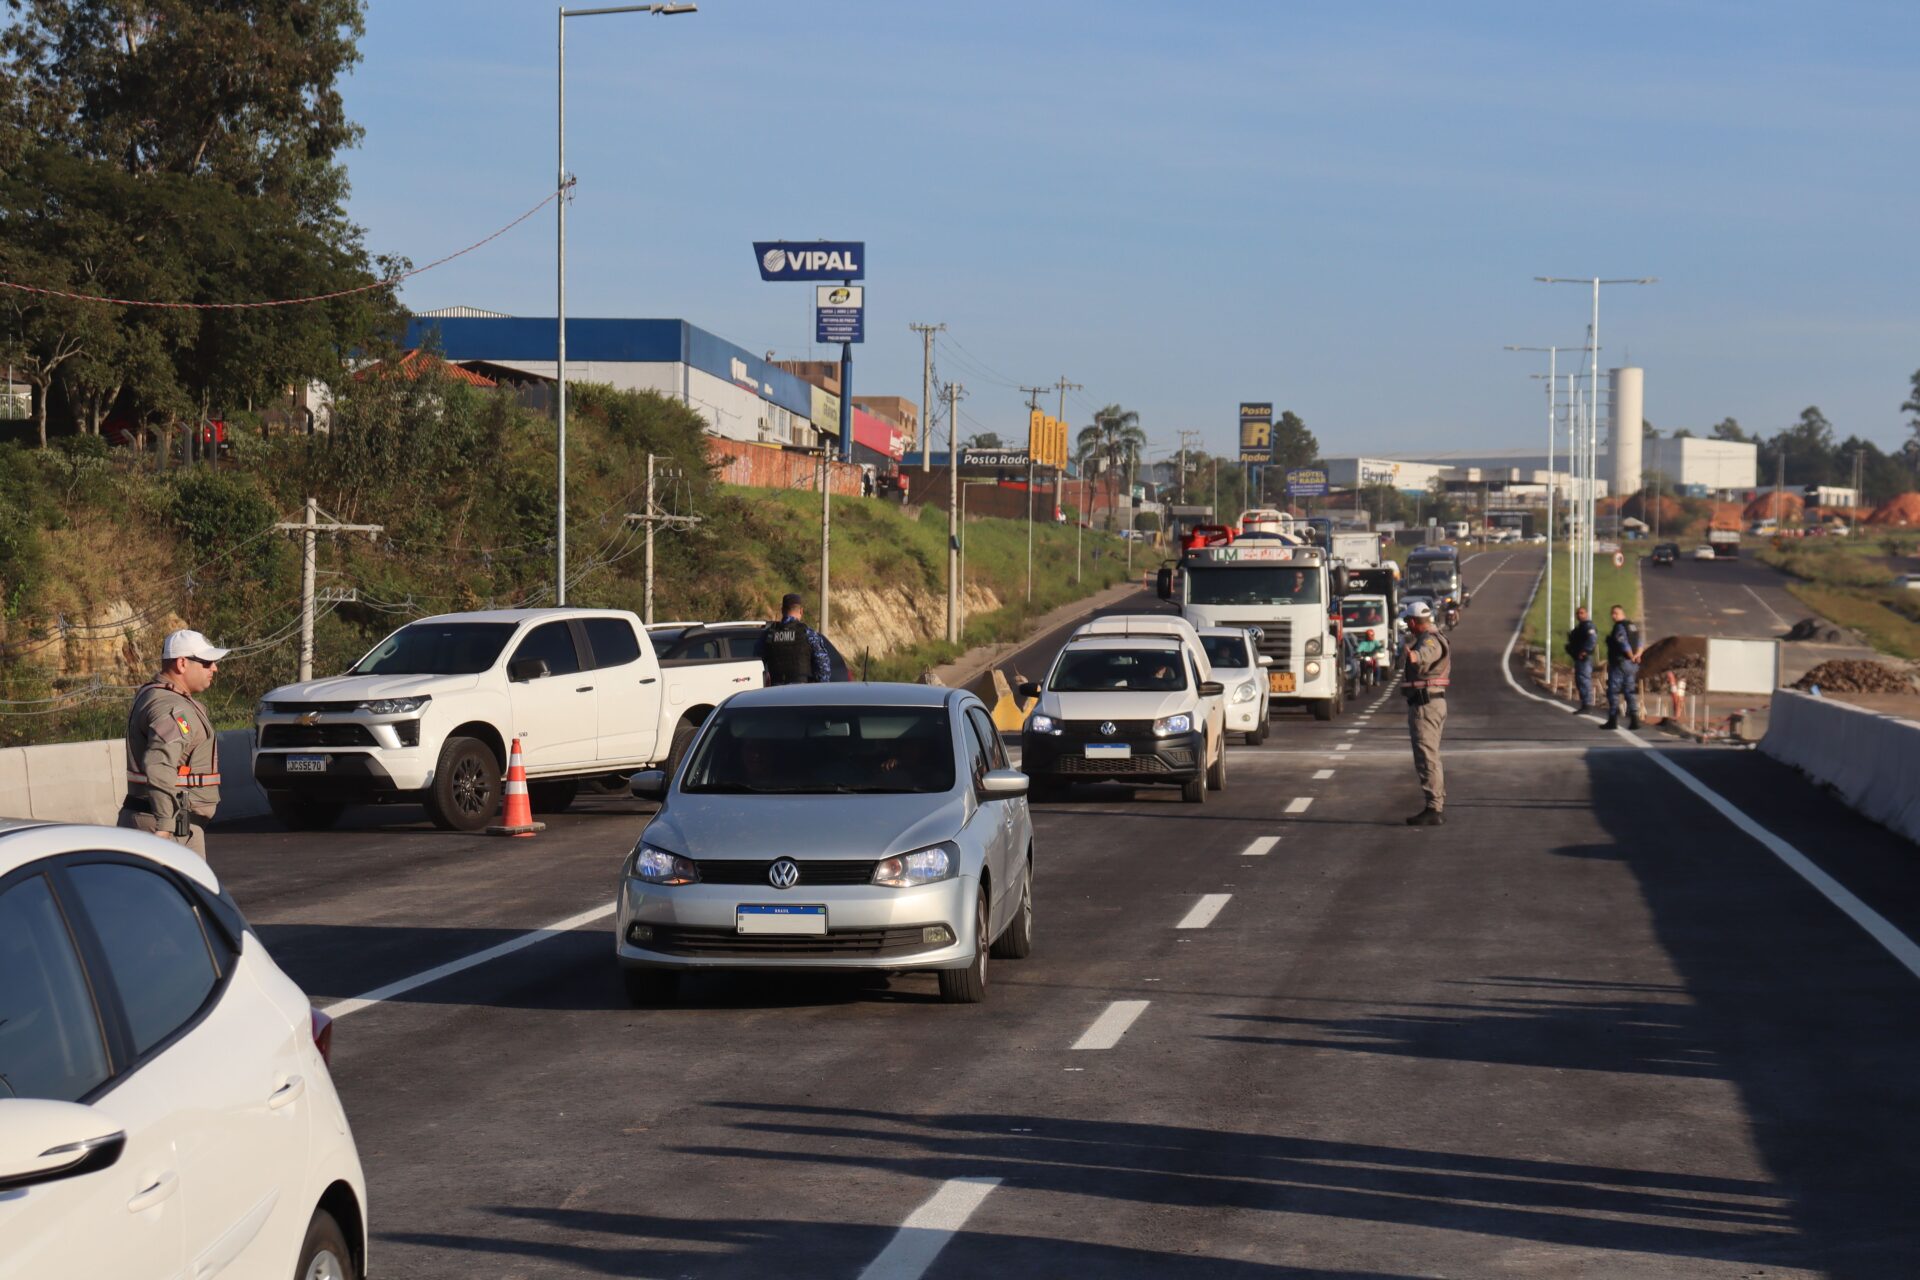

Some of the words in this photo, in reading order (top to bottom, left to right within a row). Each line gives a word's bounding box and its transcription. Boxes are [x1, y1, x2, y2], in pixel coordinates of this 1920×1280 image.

[787, 251, 858, 271] VIPAL
[1241, 407, 1271, 415] Posto
[964, 454, 997, 464] Posto
[1000, 454, 1029, 464] Rada
[1241, 453, 1270, 462] Radar
[774, 631, 795, 642] ROMU
